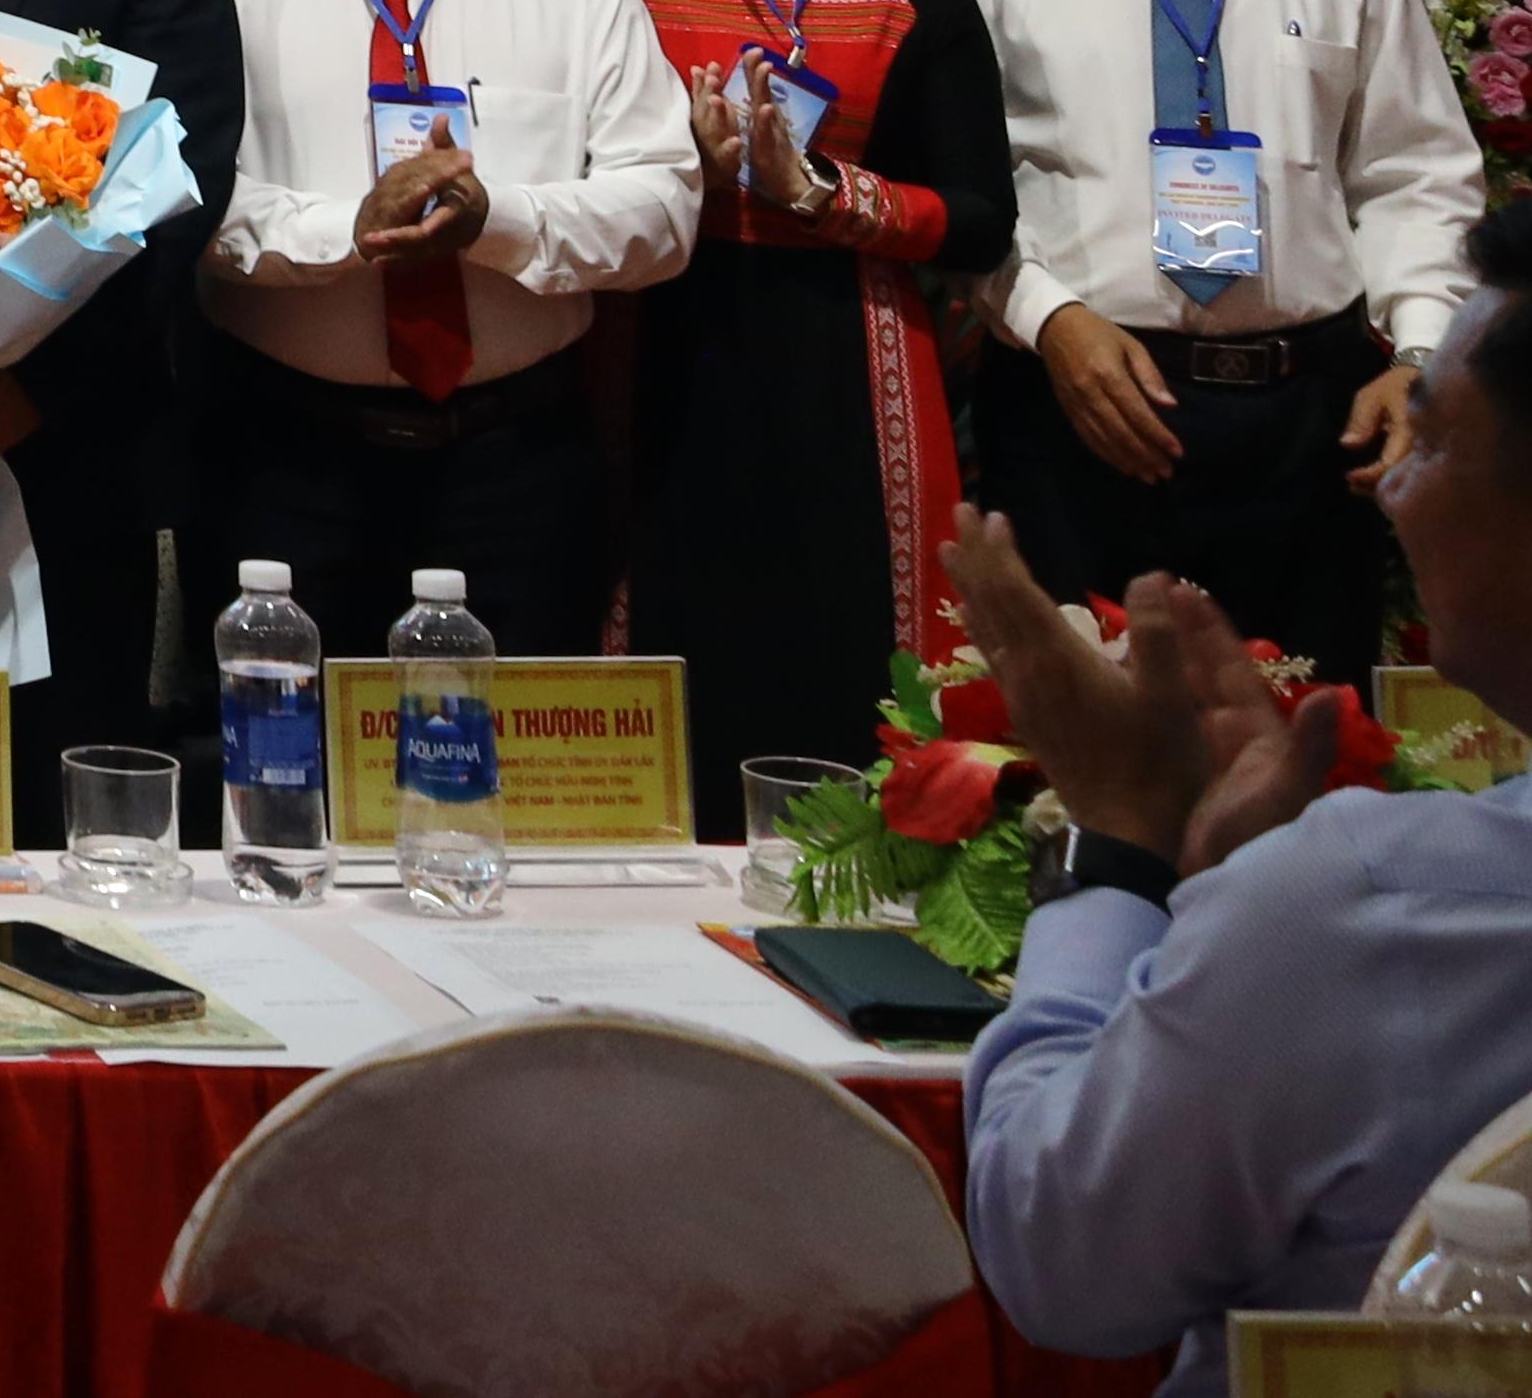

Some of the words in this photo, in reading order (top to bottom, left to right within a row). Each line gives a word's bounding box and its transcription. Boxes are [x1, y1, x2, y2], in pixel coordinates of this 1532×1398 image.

[512, 705, 607, 744] THƯỢNG
[614, 698, 654, 737] HẢI
[407, 738, 481, 764] AQUAFINA
